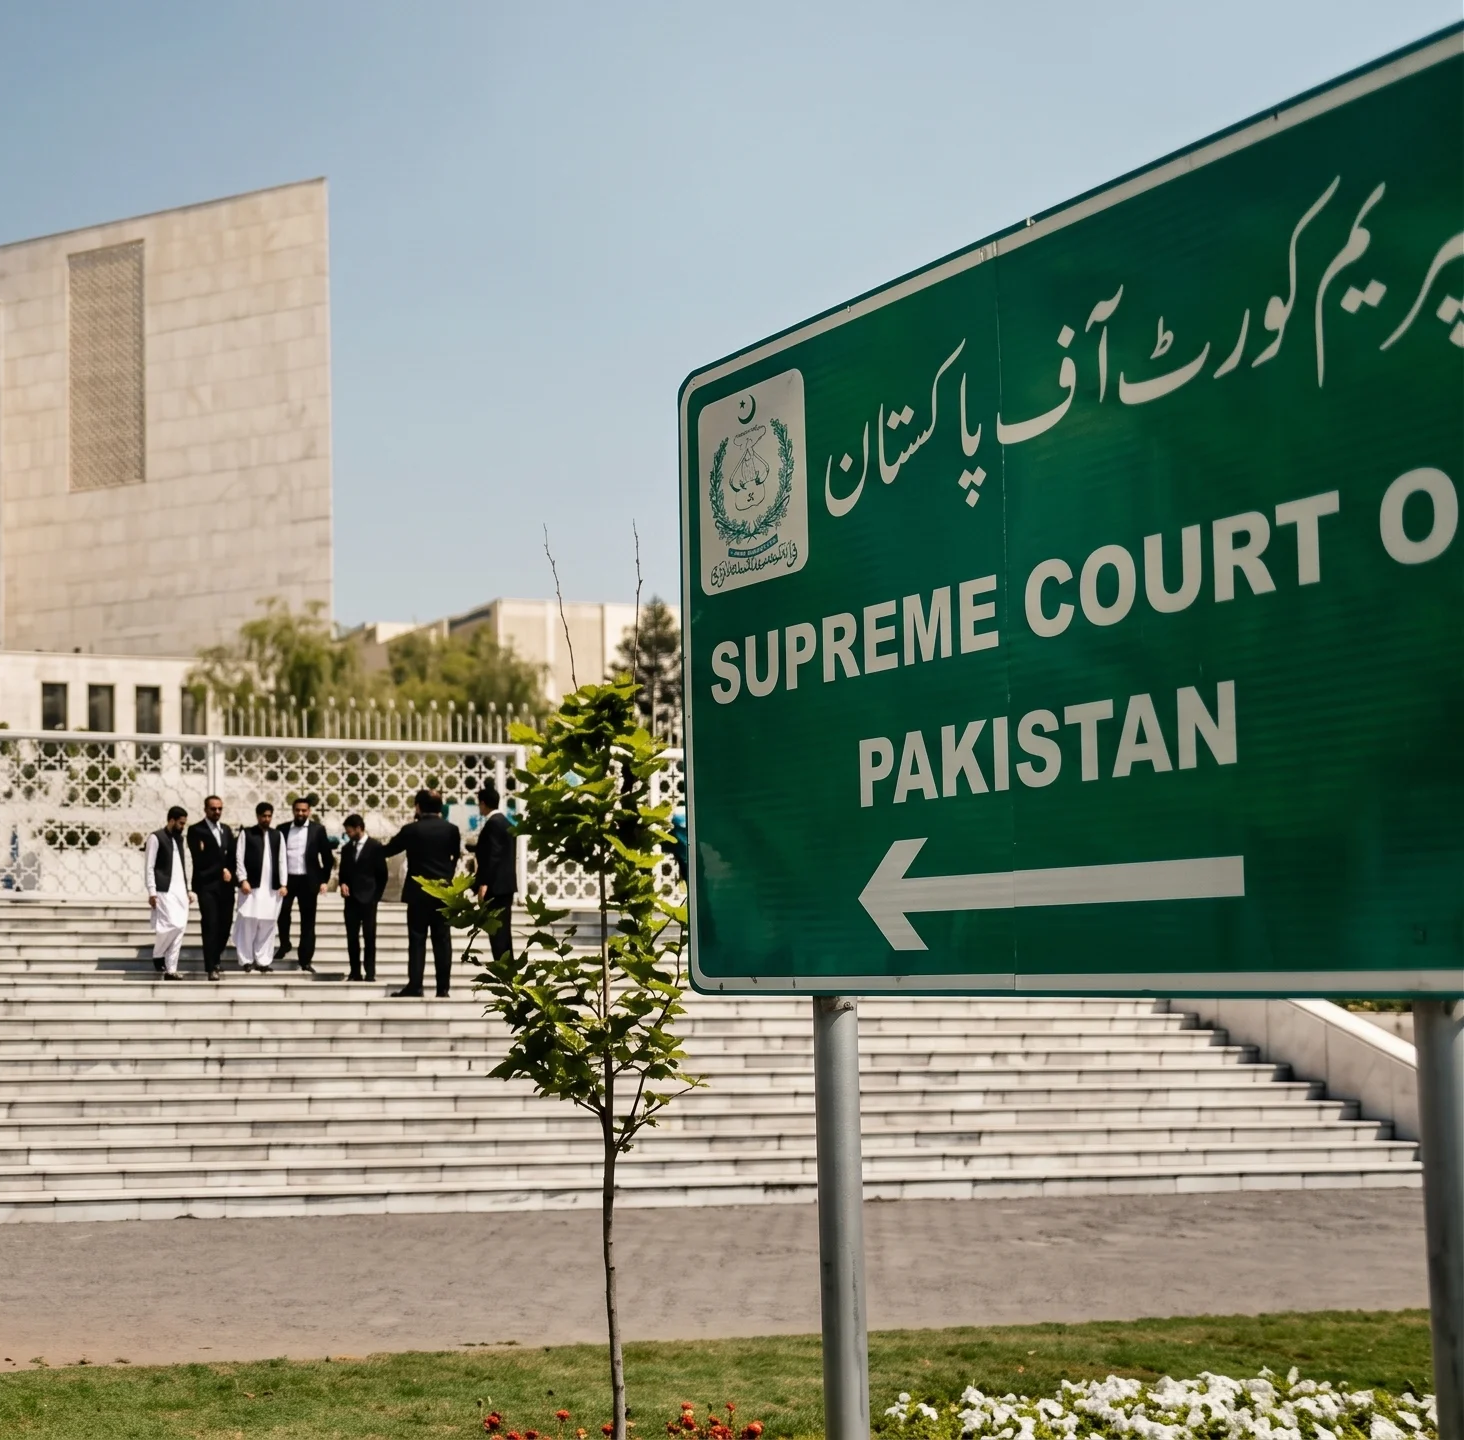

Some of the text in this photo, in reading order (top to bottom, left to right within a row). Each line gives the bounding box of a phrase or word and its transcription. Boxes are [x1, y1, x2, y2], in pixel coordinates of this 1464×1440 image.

[995, 284, 1124, 445] آف
[1117, 175, 1341, 406] کورٹ
[824, 337, 987, 517] پاکستان
[711, 466, 1459, 705] SUPREME COURT O
[858, 680, 1238, 808] PAKISTAN
